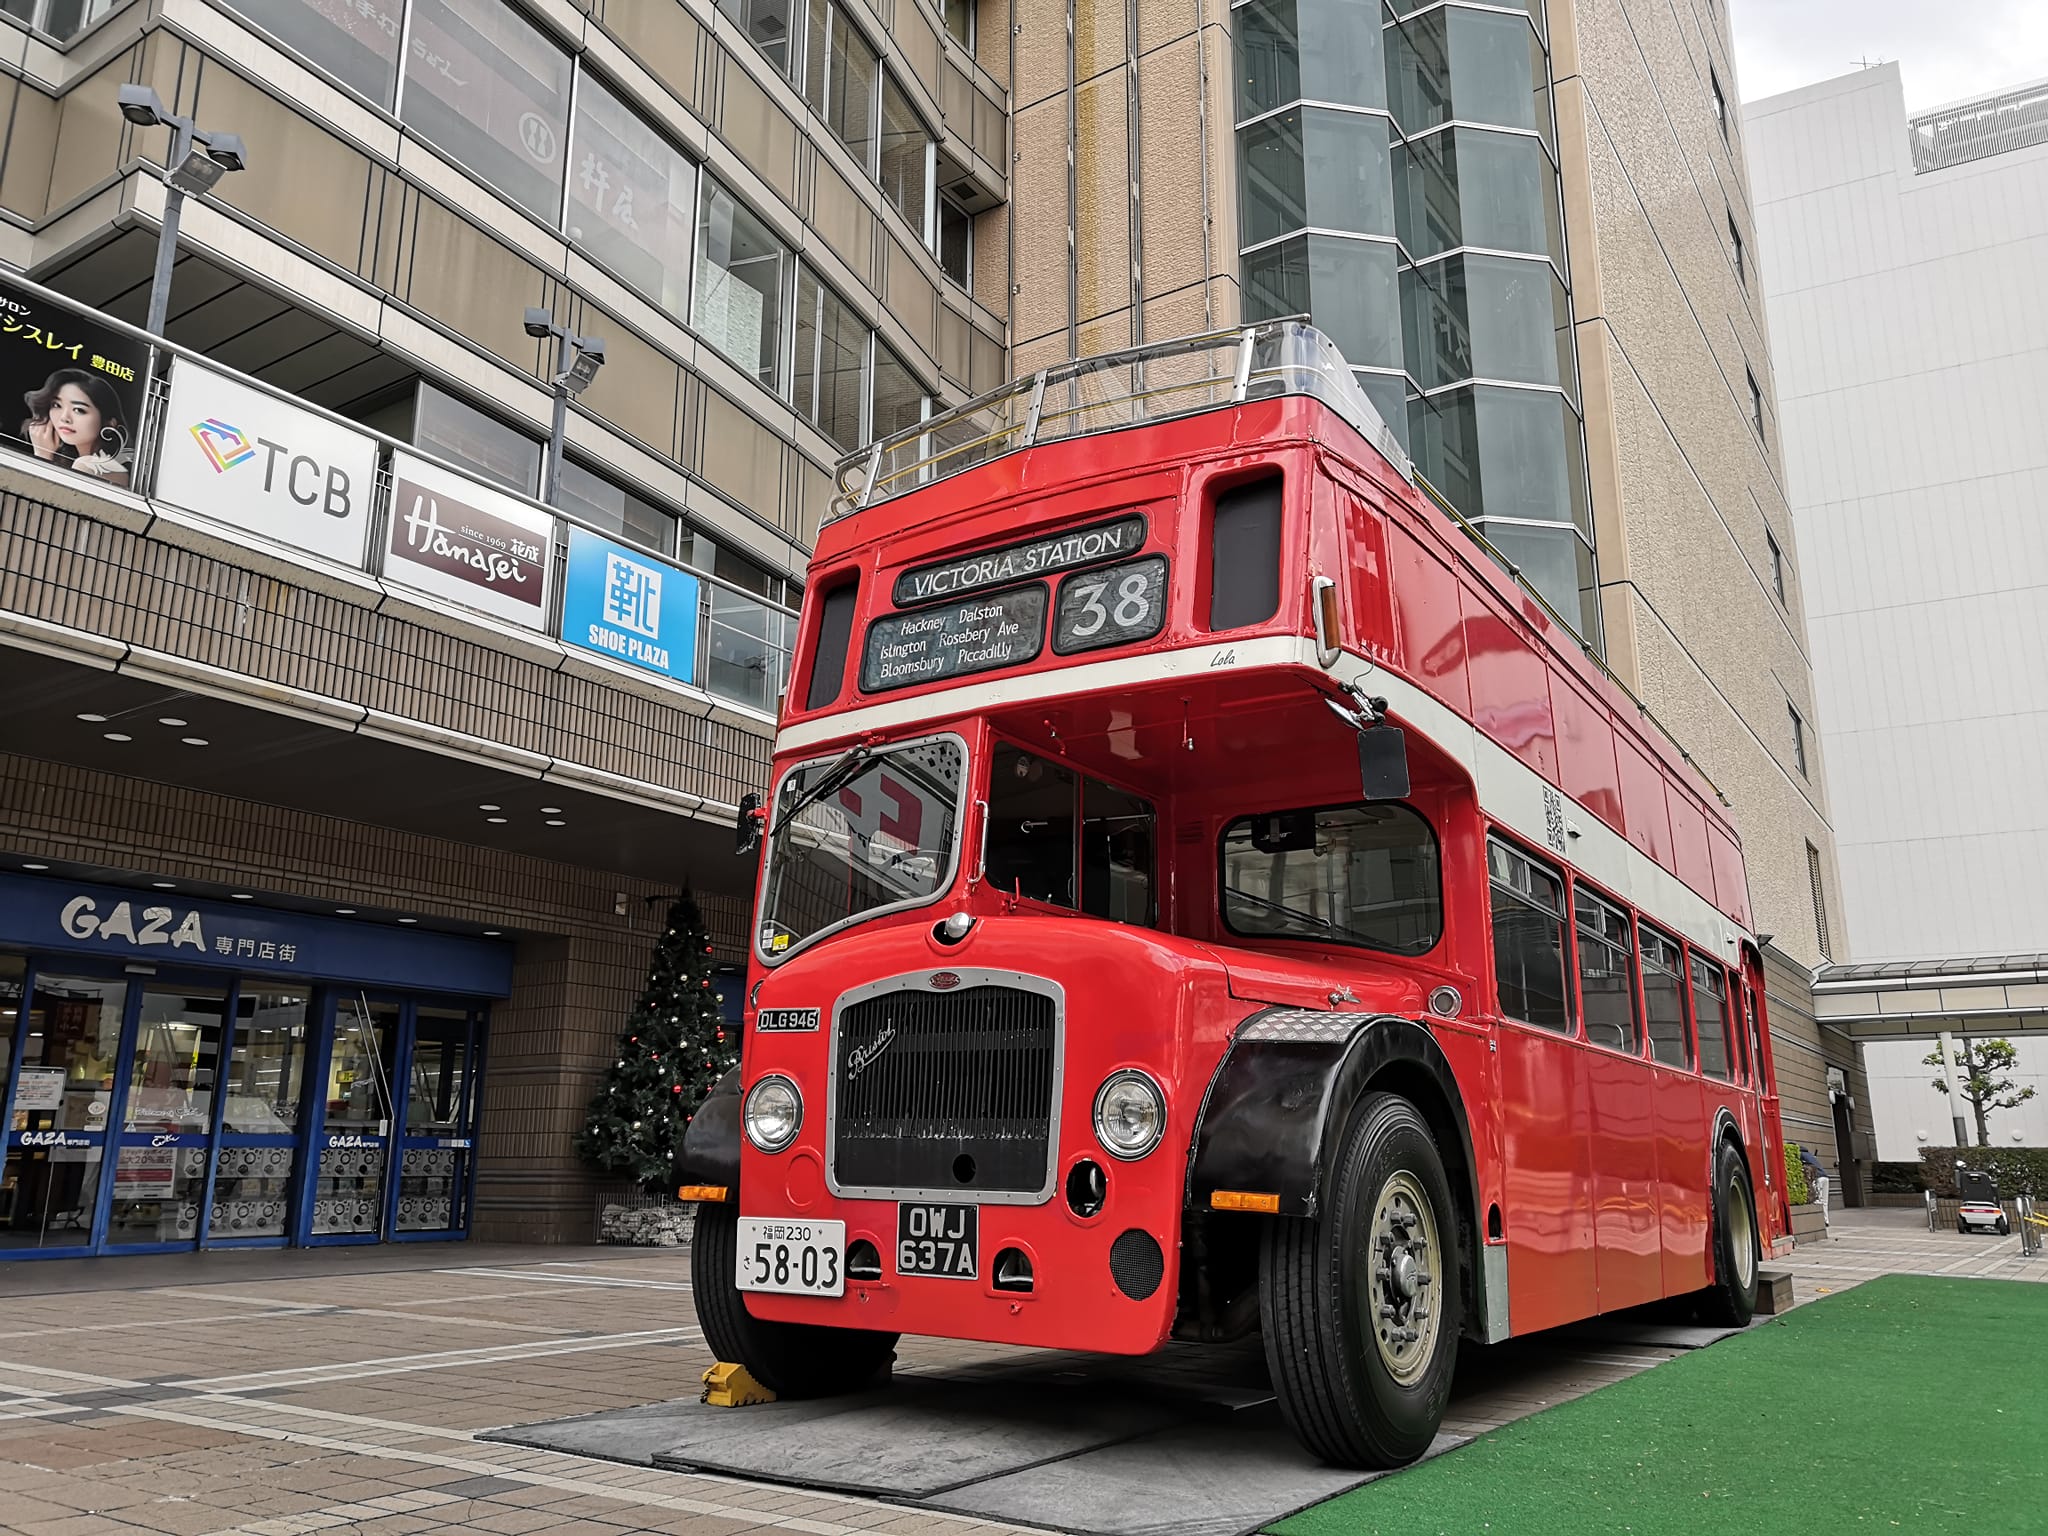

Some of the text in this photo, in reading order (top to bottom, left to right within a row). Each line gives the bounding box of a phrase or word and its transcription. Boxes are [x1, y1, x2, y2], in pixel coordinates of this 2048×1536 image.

[0, 312, 135, 382] シスレイ 豊田店
[257, 437, 351, 519] TCB
[460, 525, 506, 550] since 1969
[913, 528, 1121, 598] VICTORIA STATION
[900, 605, 1003, 636] Hackney Dalston
[1071, 572, 1149, 637] 38
[588, 623, 670, 671] SHOE PLAZA
[880, 621, 1019, 659] Islington Rosebery Ave
[1210, 649, 1235, 667] Lola
[880, 641, 1012, 679] Bloomsbury Piccadilly
[60, 896, 297, 963] GAZA 専門店街
[848, 1017, 896, 1081] Bristol
[20, 1131, 66, 1146] GAZA
[329, 1135, 362, 1148] GAZA
[909, 1207, 966, 1240] OWJ
[743, 1243, 838, 1289] さ 58-03
[899, 1240, 975, 1275] 637A
